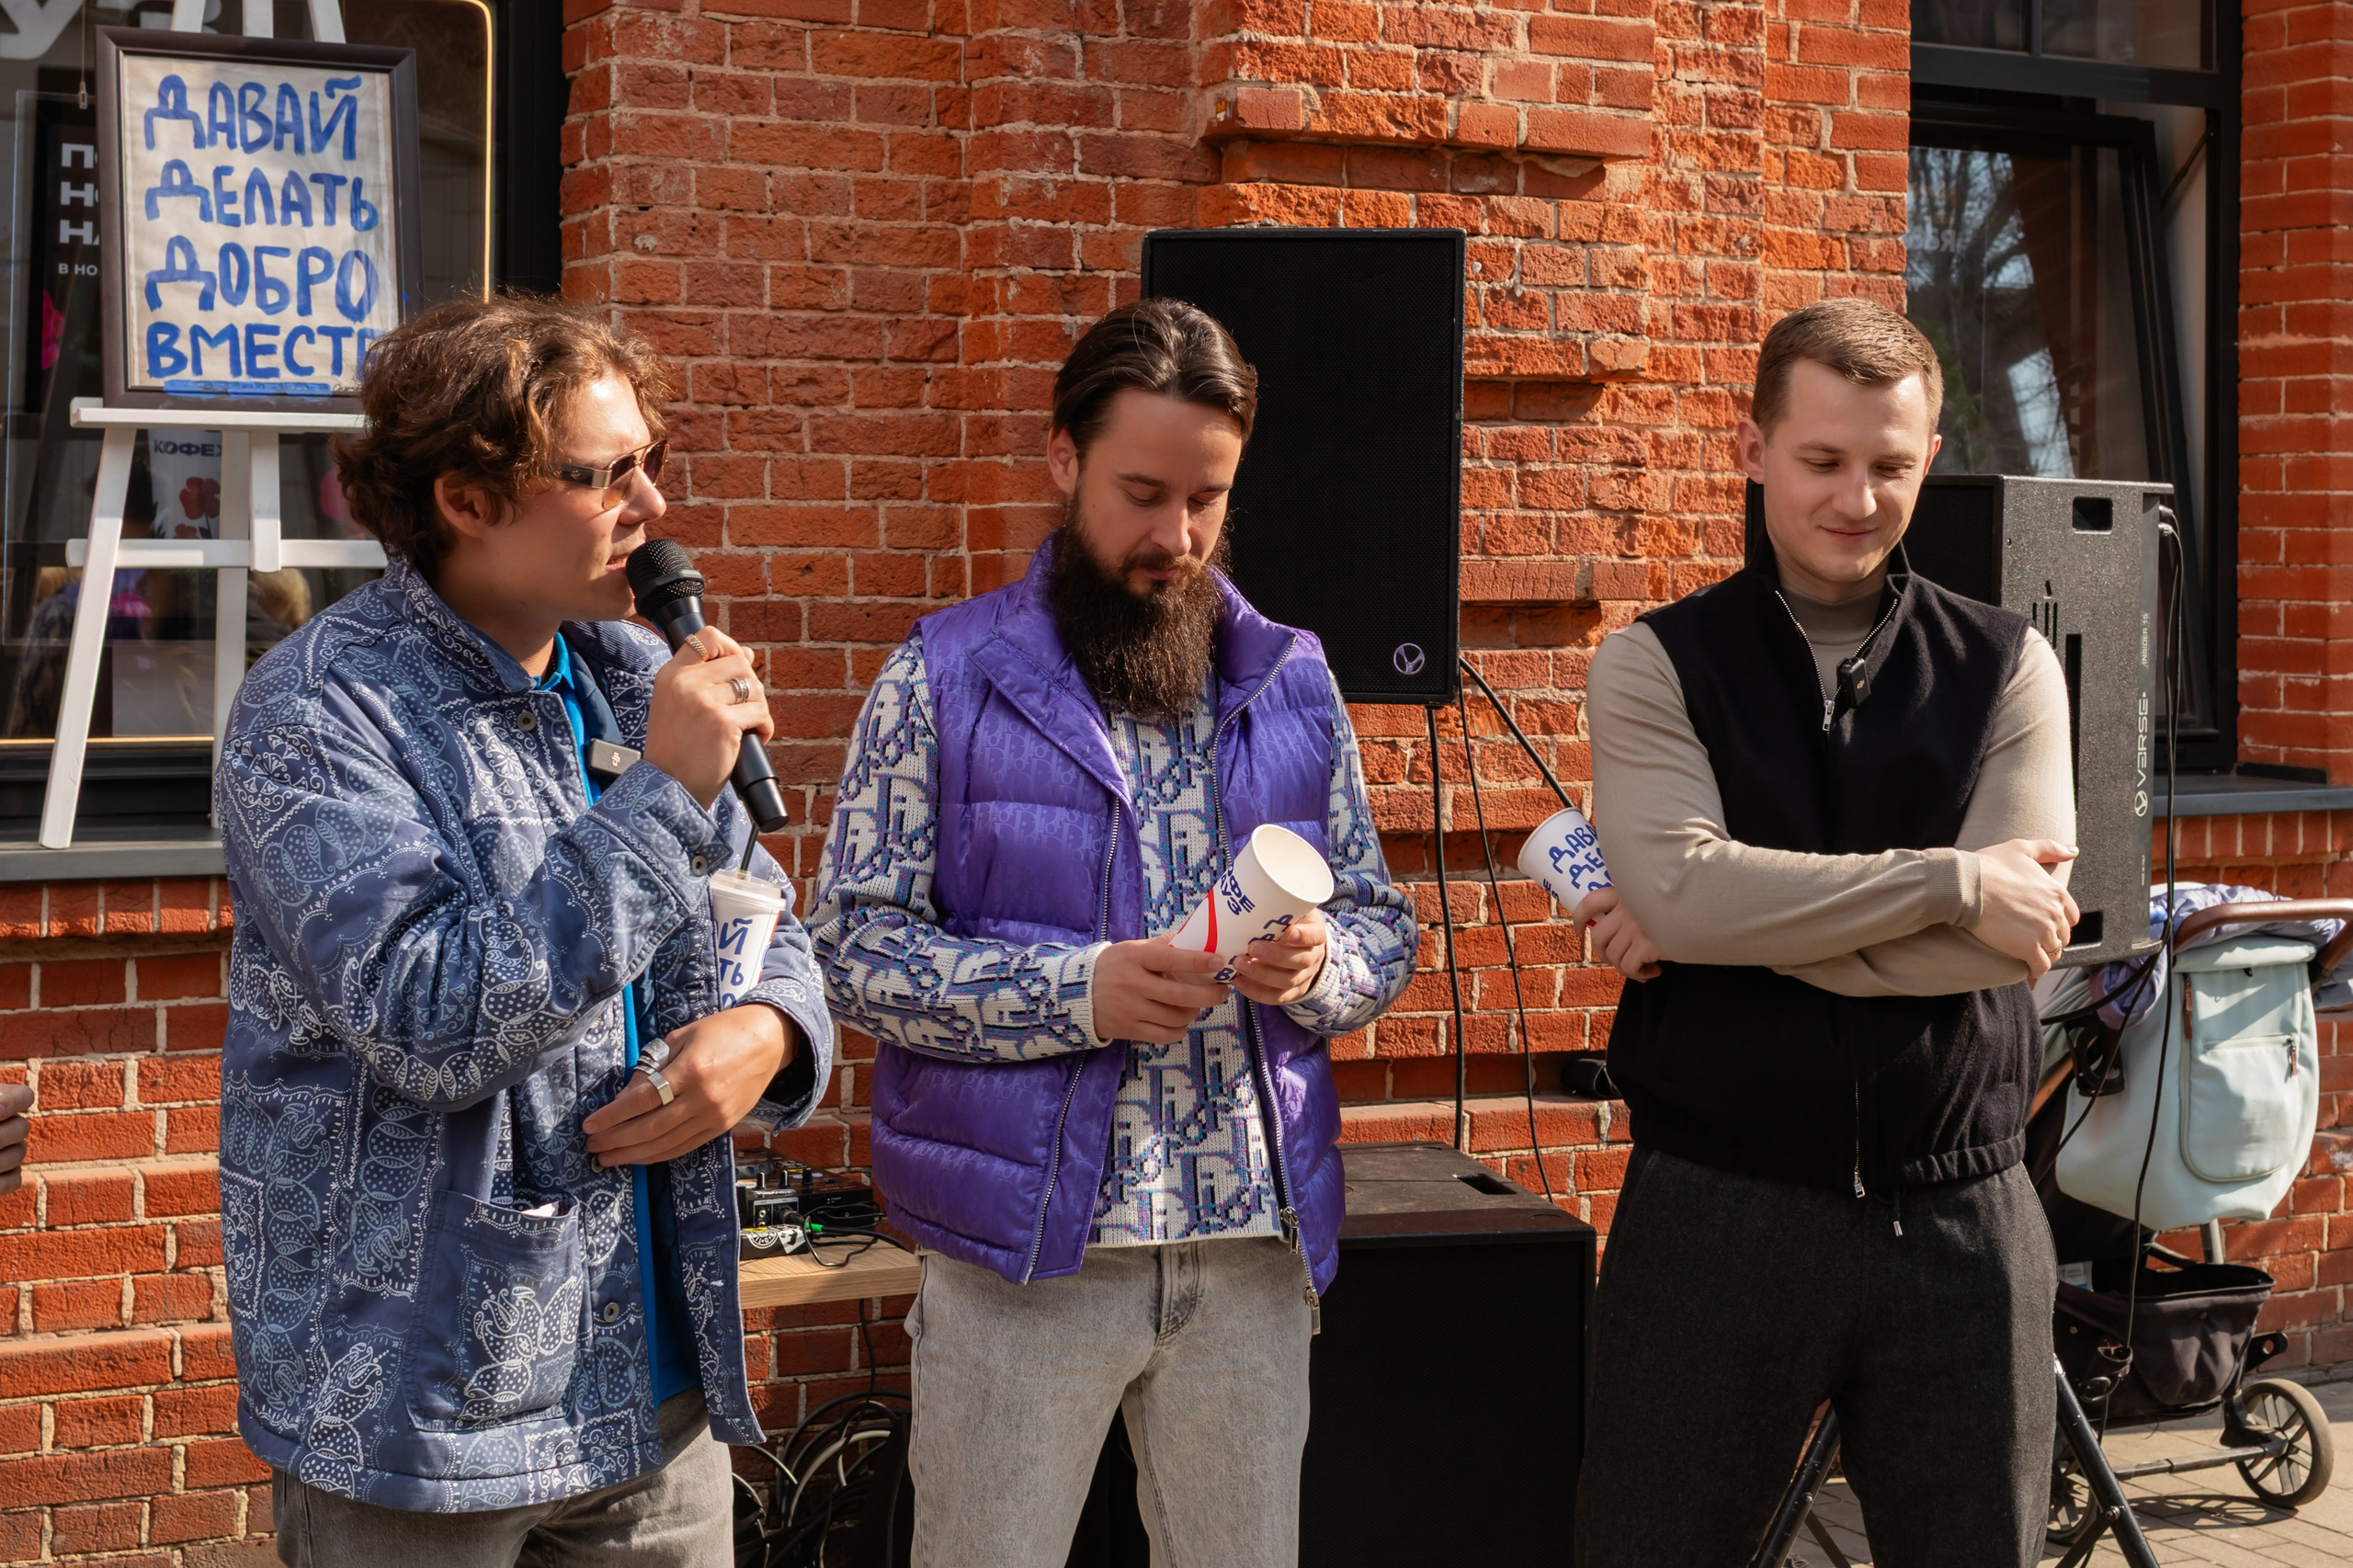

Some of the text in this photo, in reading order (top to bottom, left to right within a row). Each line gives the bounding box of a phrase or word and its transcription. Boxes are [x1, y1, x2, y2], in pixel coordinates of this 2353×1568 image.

[143, 74, 362, 161] ДАВАЙ
[144, 158, 380, 233] ДЕЛАТЬ
[58, 263, 69, 275] В
[144, 234, 380, 324] ДОБРО
[2137, 698, 2149, 788] VERSE
